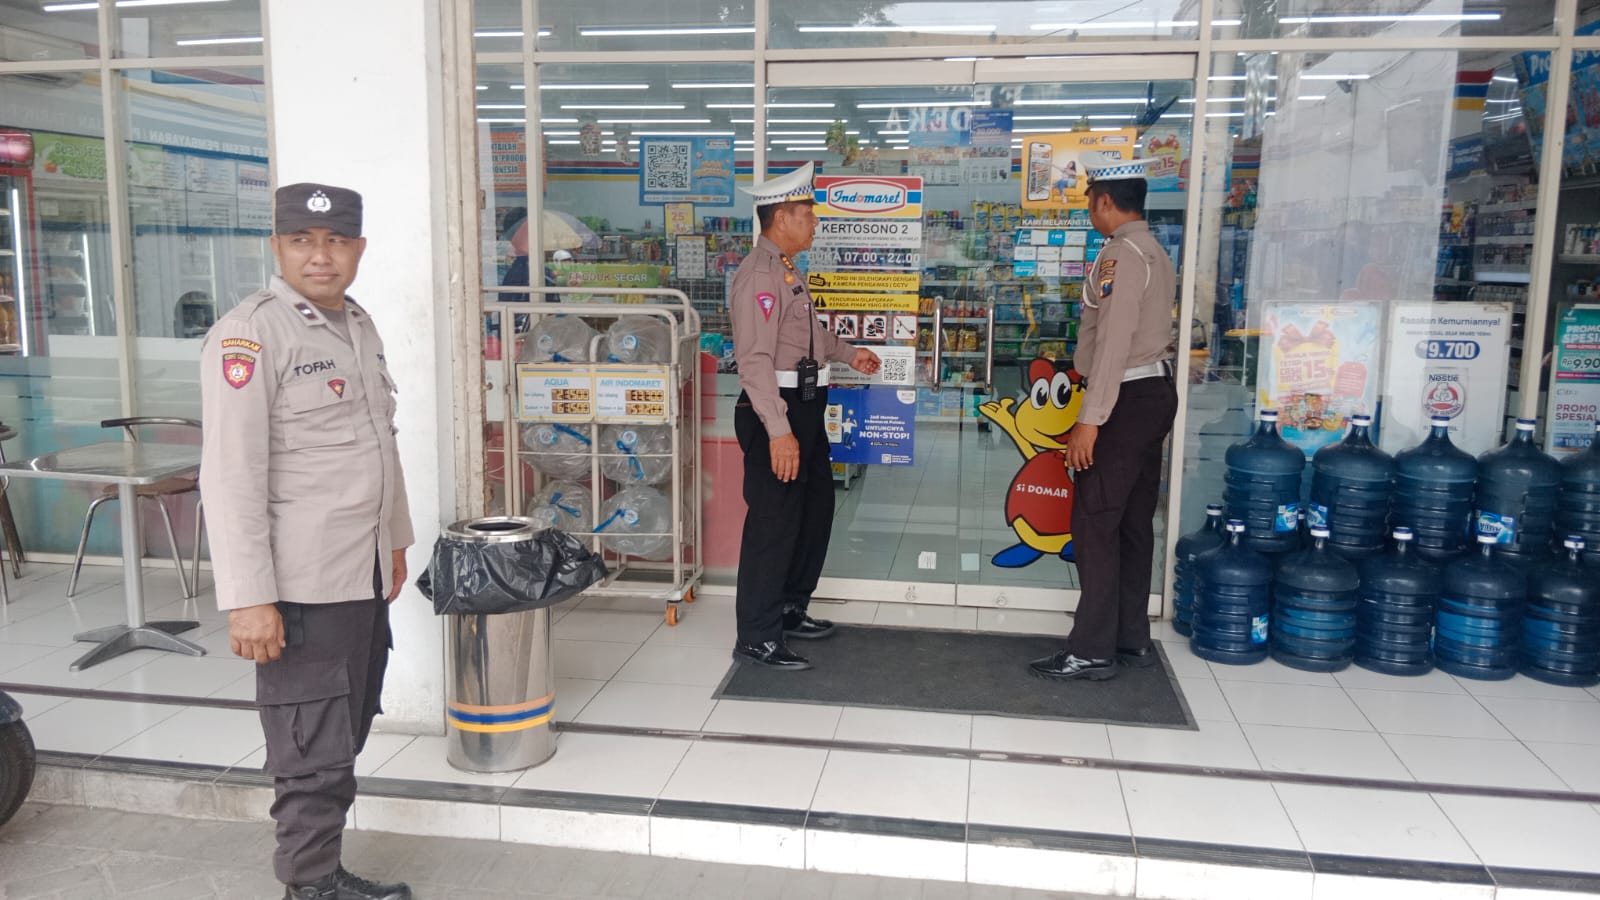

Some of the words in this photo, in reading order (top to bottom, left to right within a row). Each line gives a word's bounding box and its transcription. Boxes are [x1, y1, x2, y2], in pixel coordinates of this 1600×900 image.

[831, 190, 901, 204] Indomaret
[821, 223, 898, 235] KERTOSONO
[901, 224, 909, 234] 2
[844, 251, 877, 263] 07.00
[568, 272, 610, 282] PRODUK
[614, 272, 647, 282] SEGAR
[1438, 316, 1500, 328] Kemurniannya!
[1428, 342, 1475, 359] 9.700
[294, 359, 336, 377] TOFAH
[544, 378, 569, 386] AQUA
[615, 379, 662, 387] INDOMARET
[1555, 404, 1597, 413] PROMO
[859, 430, 910, 440] NON-STOP!
[1016, 483, 1025, 492] Si
[1027, 484, 1068, 498] DOMAR
